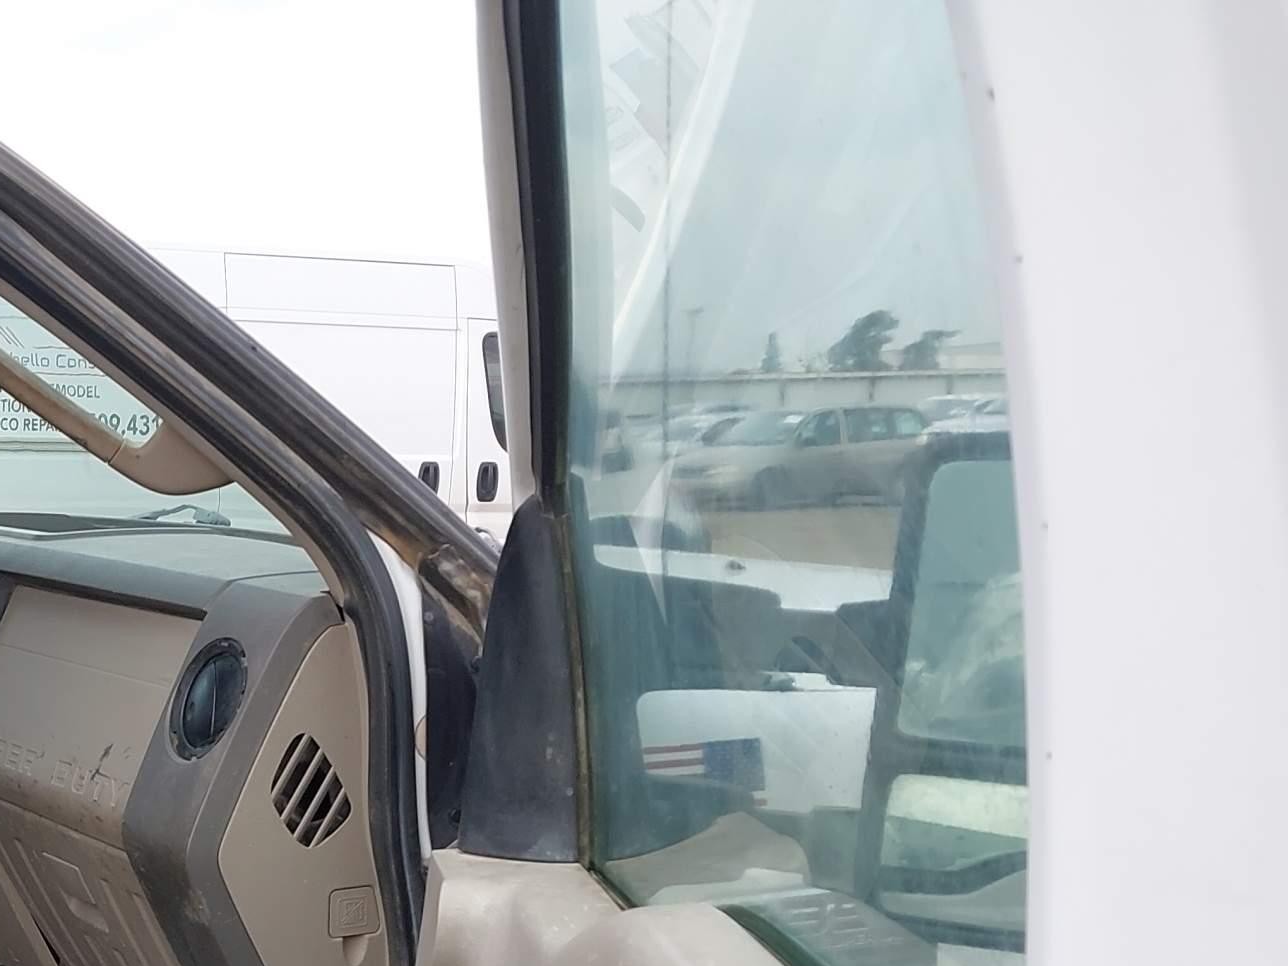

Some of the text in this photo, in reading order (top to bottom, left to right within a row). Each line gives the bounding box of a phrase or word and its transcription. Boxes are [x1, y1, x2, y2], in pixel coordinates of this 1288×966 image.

[52, 383, 101, 398] MODEL
[23, 418, 58, 432] REPA
[88, 412, 159, 435] 09.431
[50, 759, 131, 808] DUTY
